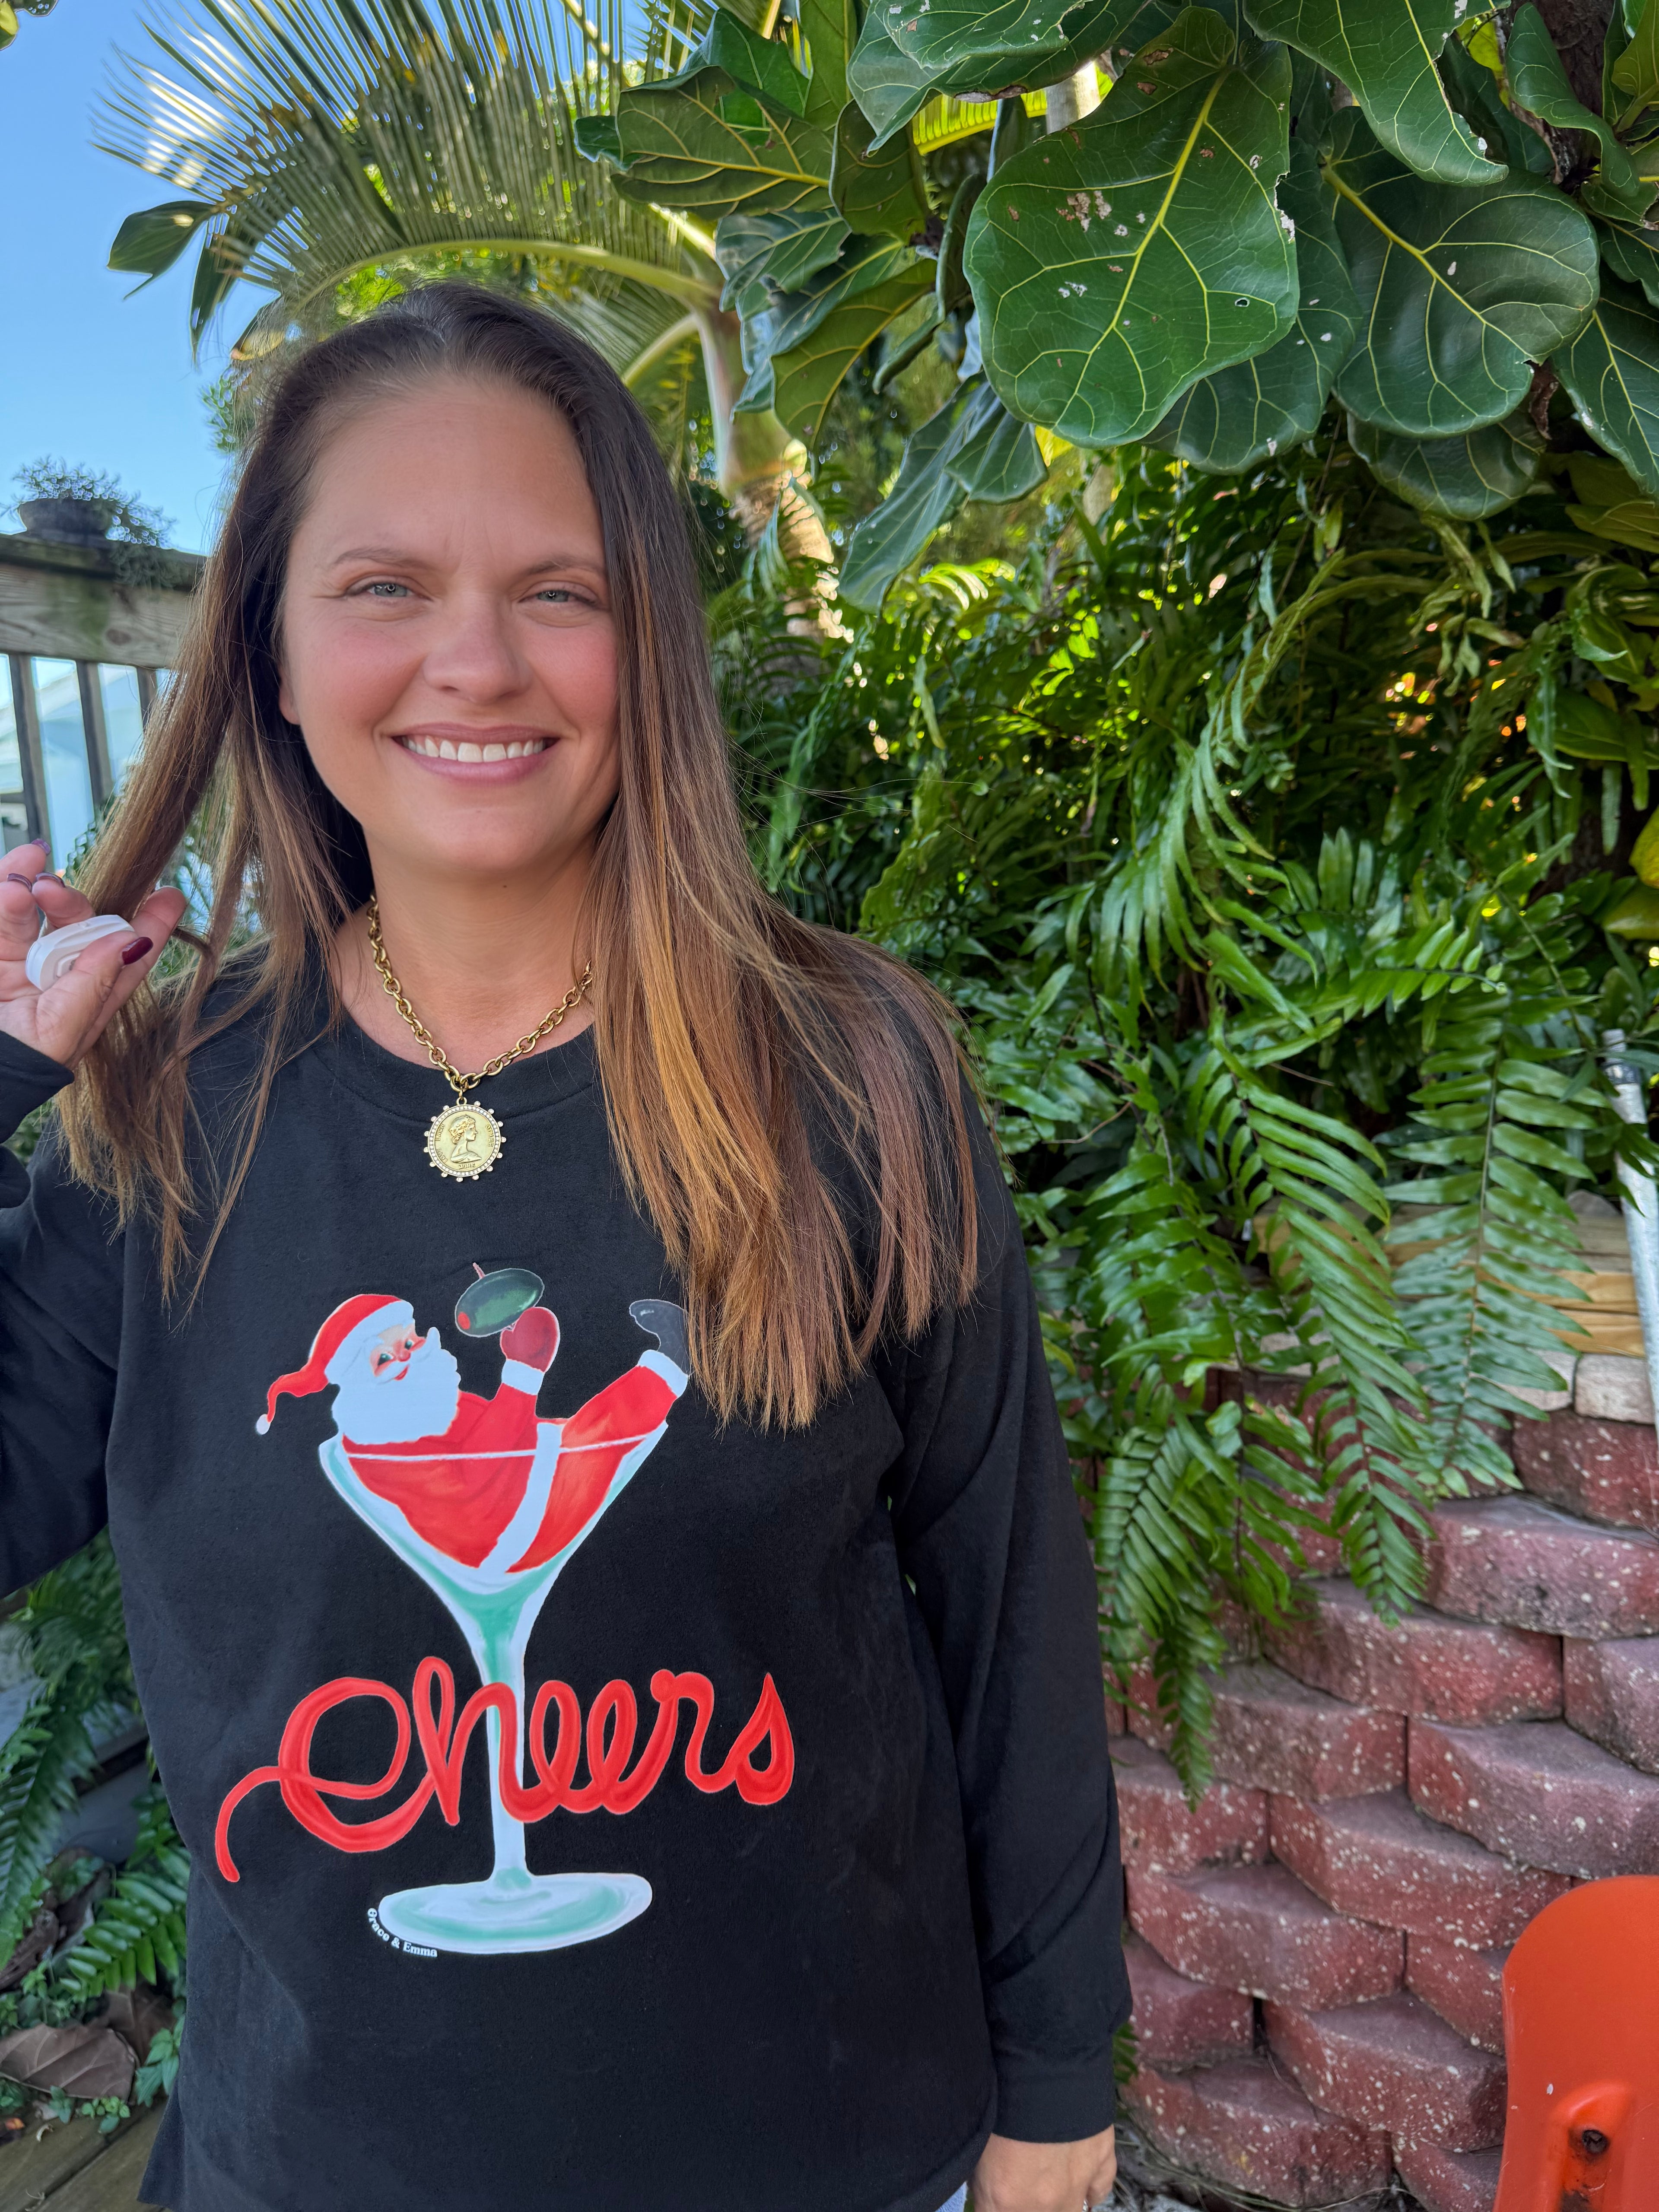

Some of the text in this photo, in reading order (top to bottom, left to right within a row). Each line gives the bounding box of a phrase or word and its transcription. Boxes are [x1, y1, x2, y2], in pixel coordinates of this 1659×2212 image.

[435, 1124, 445, 1141] EACH
[486, 1125, 494, 1147] OTHER
[436, 1148, 448, 1163] LOVE
[215, 1657, 794, 1882] Cheers
[367, 1908, 438, 1958] Grace & Emma
